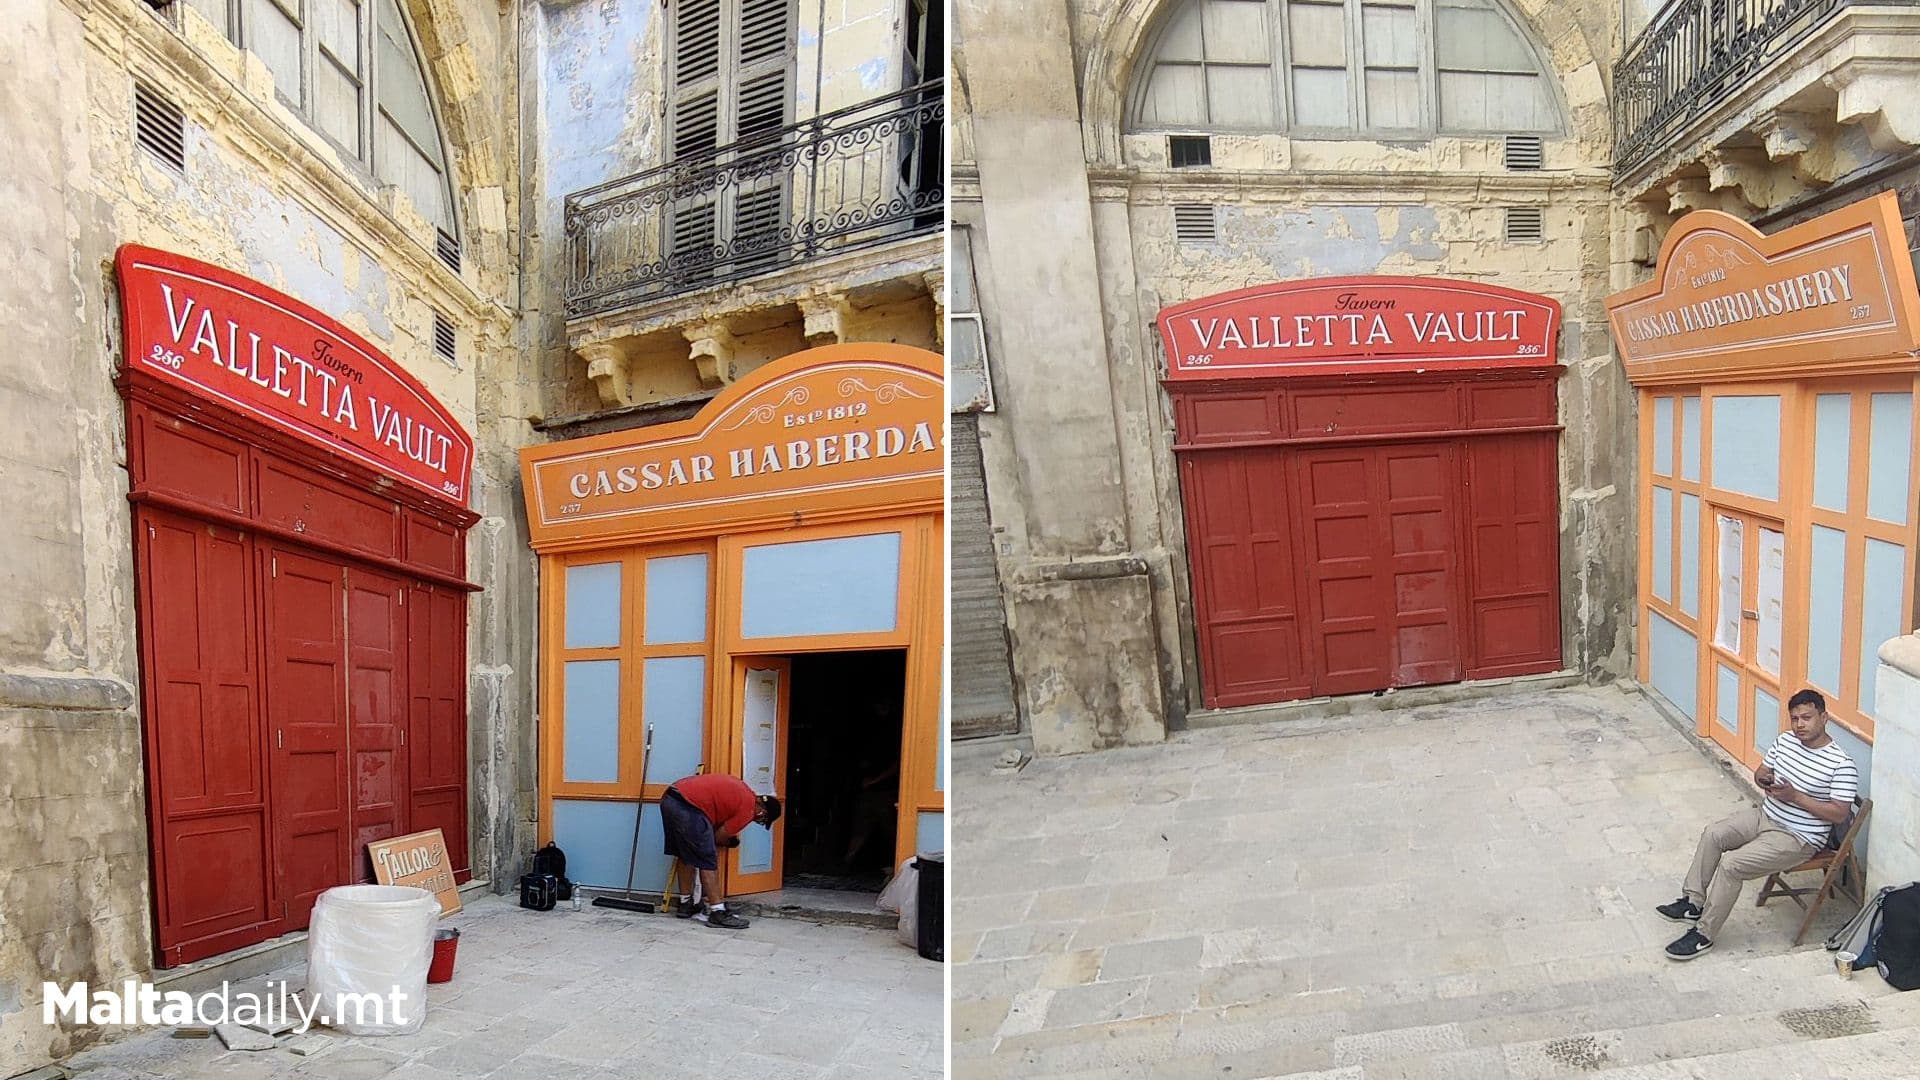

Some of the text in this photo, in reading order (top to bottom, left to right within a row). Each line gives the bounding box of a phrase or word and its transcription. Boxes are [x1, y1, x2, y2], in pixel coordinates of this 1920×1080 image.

[1335, 292, 1397, 311] Tavern
[1627, 264, 1853, 341] CASSAR HABERDASHERY
[1190, 309, 1528, 350] VALLETTA VAULT
[150, 344, 186, 371] 256
[312, 338, 364, 386] Tavern
[1186, 353, 1214, 366] 256
[1516, 343, 1542, 355] 256
[160, 282, 453, 474] VALLETTA VAULT
[826, 401, 868, 421] 1812
[569, 420, 944, 499] CASSAR HABERDA
[443, 480, 459, 496] 256
[429, 842, 444, 867] &
